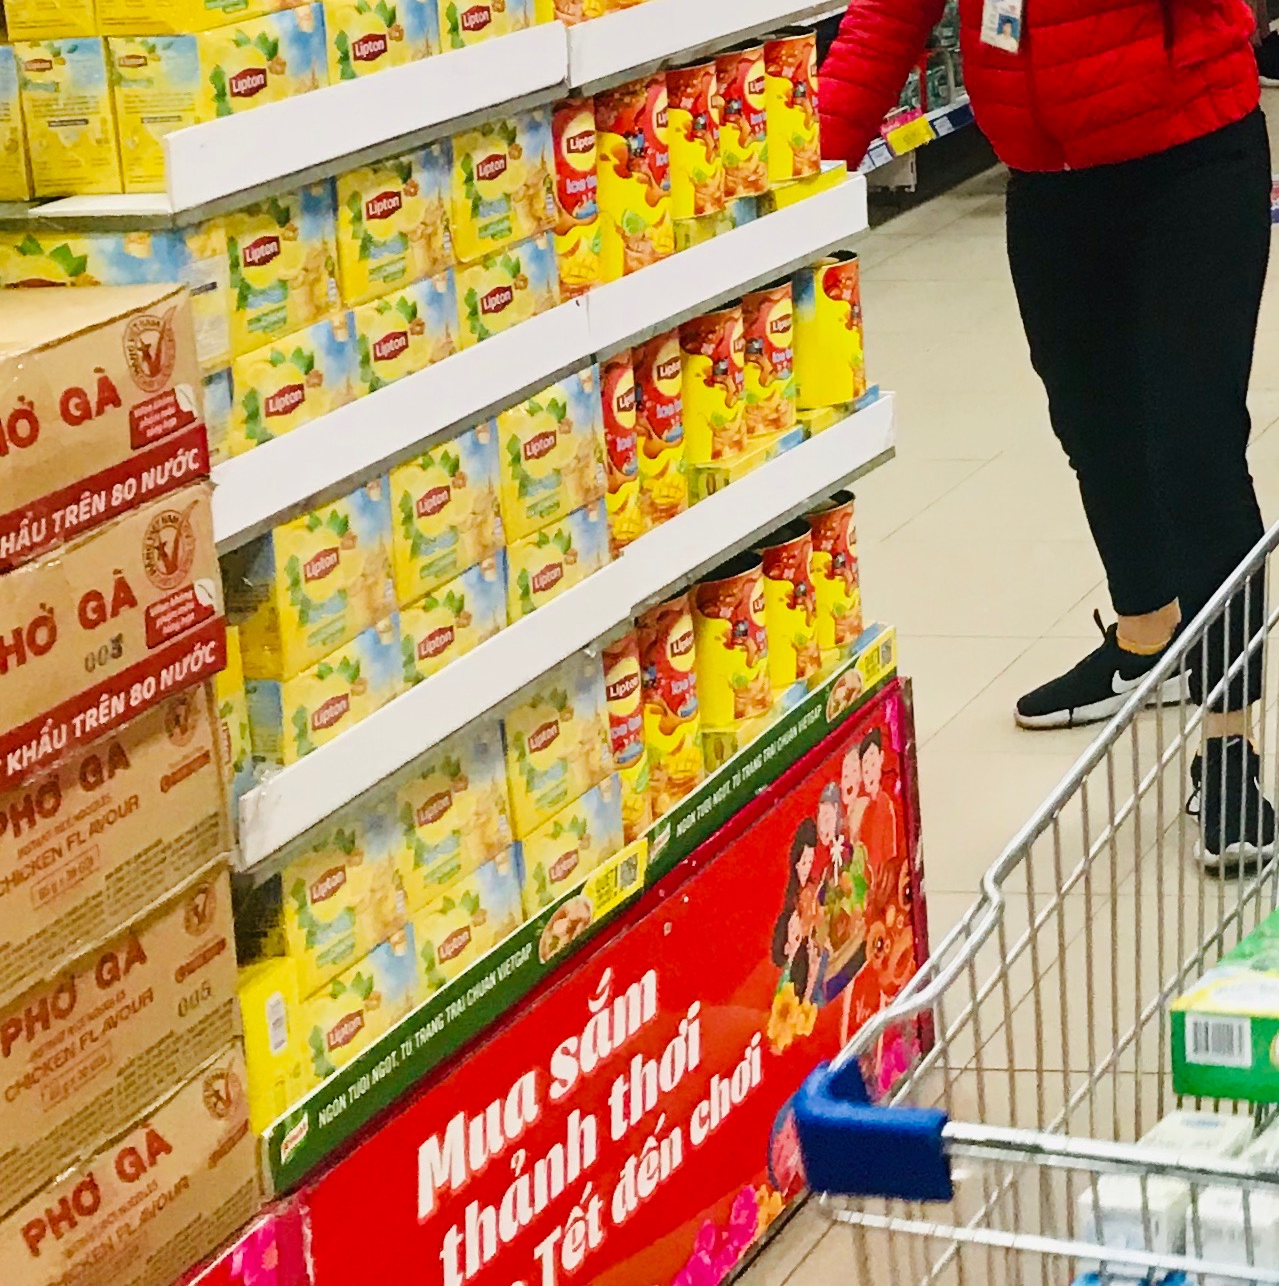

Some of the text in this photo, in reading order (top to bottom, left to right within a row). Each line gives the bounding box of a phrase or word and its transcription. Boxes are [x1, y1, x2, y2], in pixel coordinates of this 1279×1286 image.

[354, 39, 385, 57] Lipton
[463, 10, 490, 27] Lipton
[232, 74, 264, 93] Lipton
[369, 196, 400, 214] Lipton
[247, 242, 278, 262] Lipton
[60, 367, 122, 427] GÀ
[0, 448, 200, 558] HẨU TRÊN 80 NƯỚC
[78, 569, 138, 630] GÀ
[7, 640, 216, 775] KHẨU TRÊN 80 NƯỚC
[67, 794, 140, 850] FLAVOUR
[5, 987, 153, 1103] CHICKEN FLAVOUR
[414, 1013, 445, 1048] TRANG
[418, 968, 657, 1221] Mua sắm
[441, 1001, 701, 1286] thảnh thơi
[612, 1117, 682, 1225] đến
[689, 1033, 762, 1146] chơi
